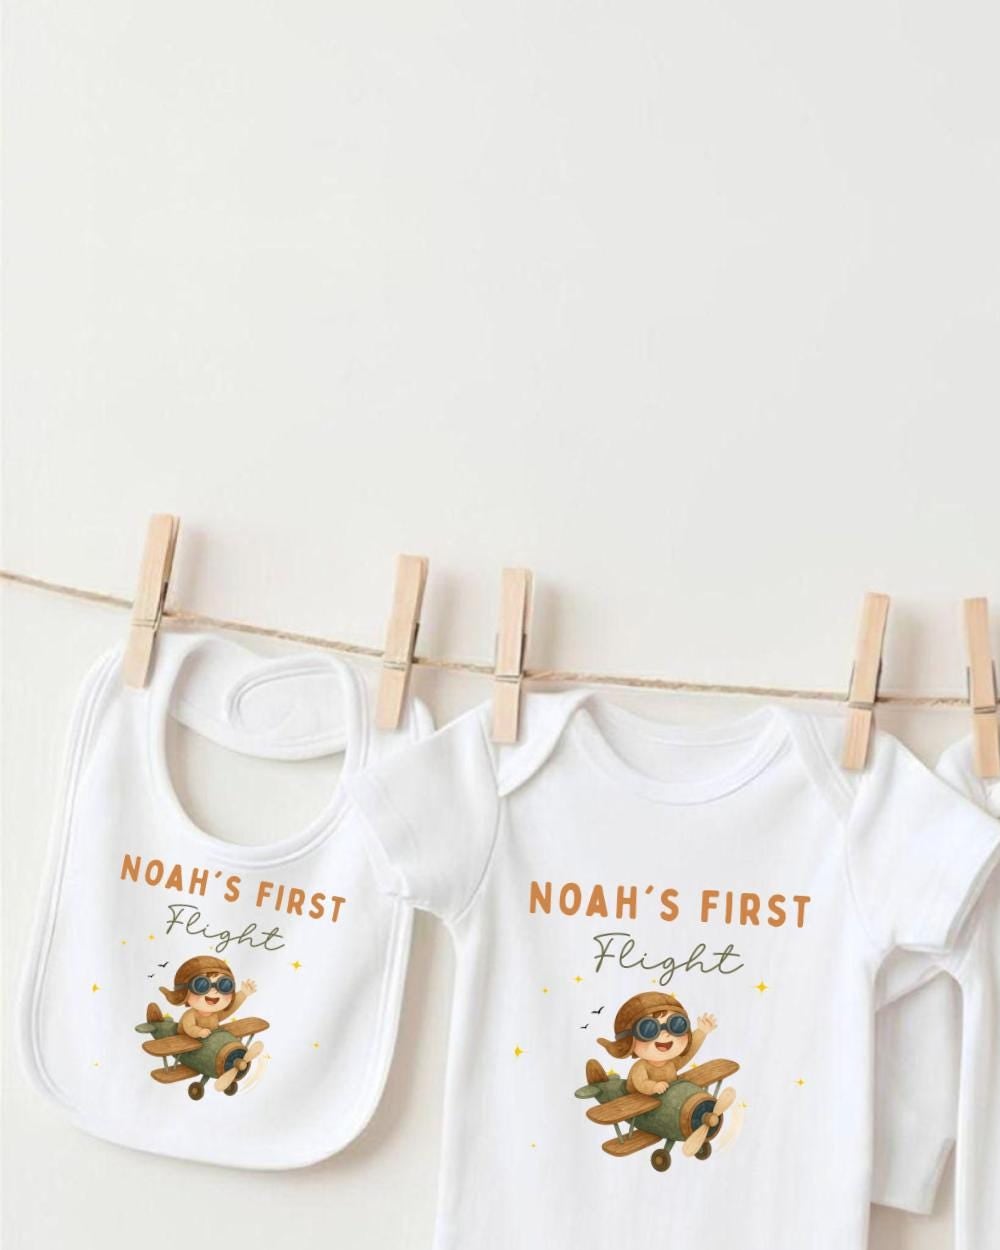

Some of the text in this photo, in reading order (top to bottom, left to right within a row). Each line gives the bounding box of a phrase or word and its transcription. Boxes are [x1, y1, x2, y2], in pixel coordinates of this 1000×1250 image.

[120, 854, 346, 923] NOAH'S FIRST
[529, 880, 811, 929] NOAH'S FIRST
[165, 903, 286, 954] Flight
[592, 932, 745, 987] Flight
